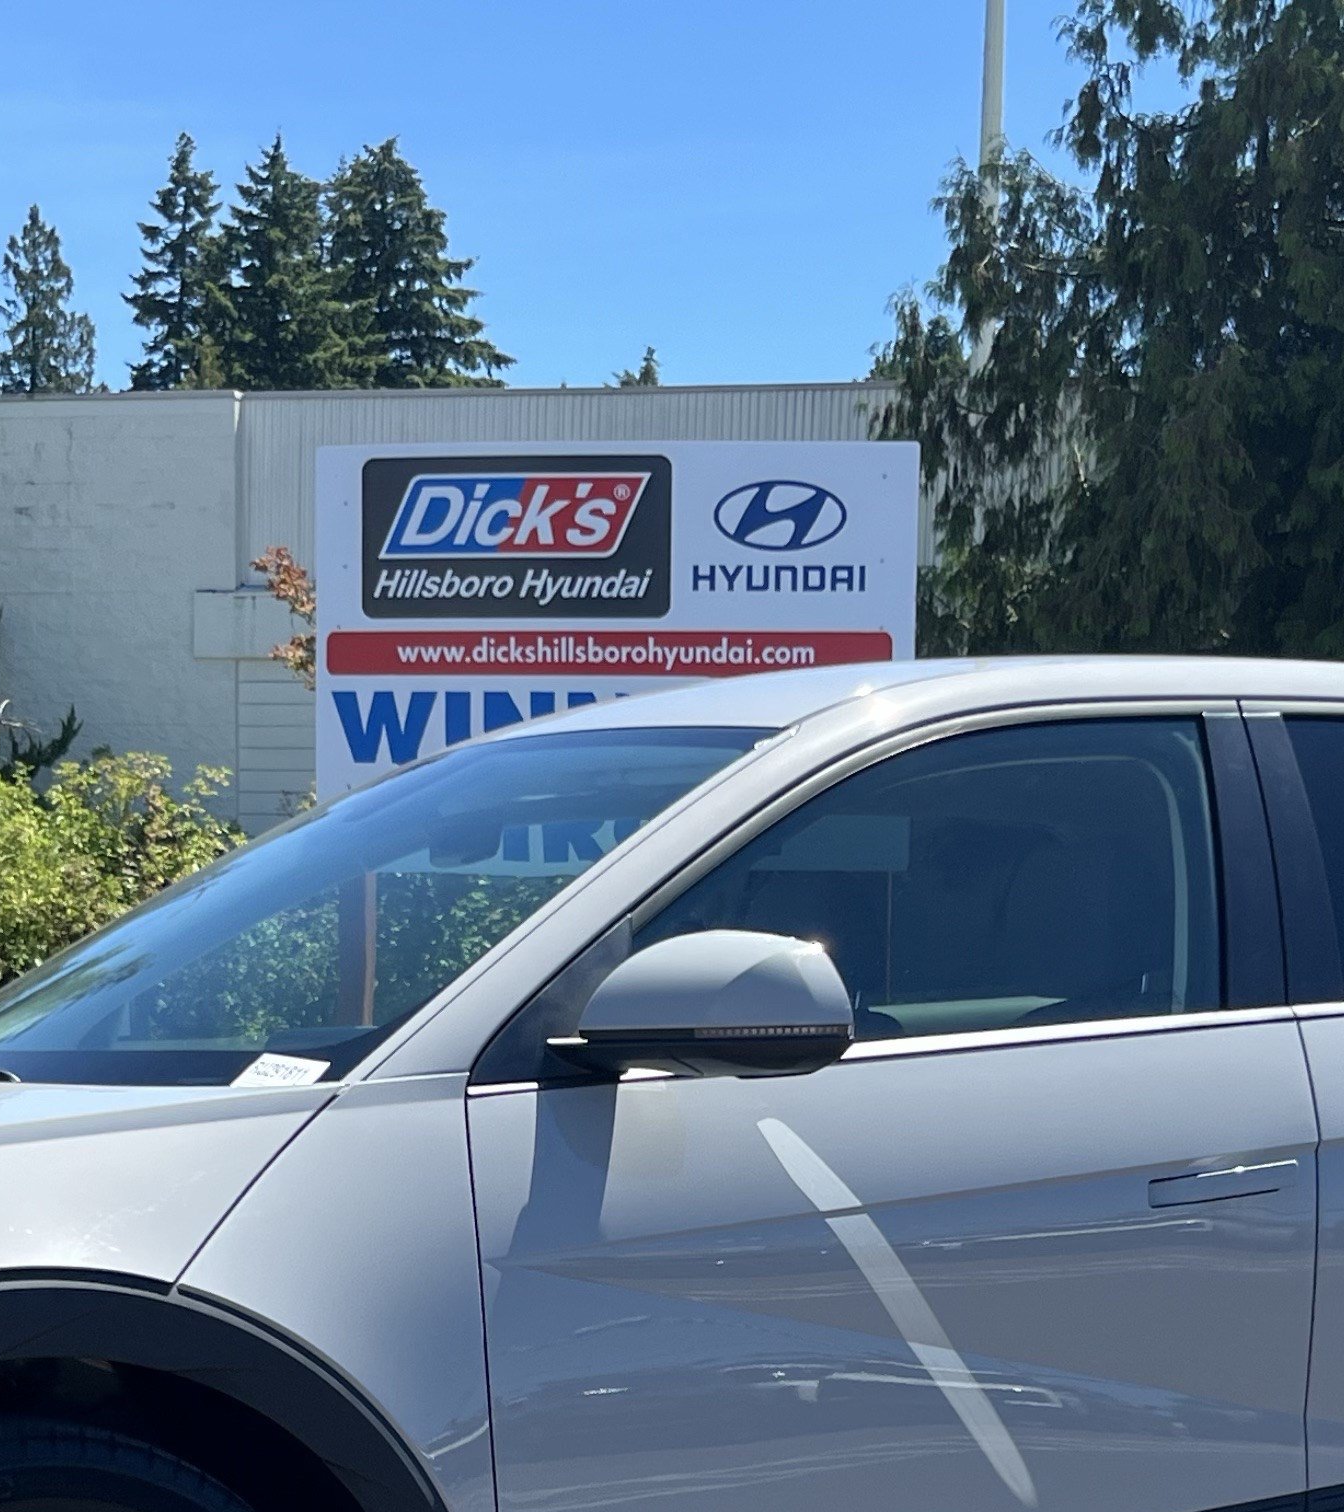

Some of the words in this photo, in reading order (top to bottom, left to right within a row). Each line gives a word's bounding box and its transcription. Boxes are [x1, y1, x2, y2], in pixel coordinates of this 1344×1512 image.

[399, 483, 617, 546] Dick's
[373, 568, 515, 599] Hillsboro
[519, 568, 653, 606] Hyundai
[692, 565, 866, 593] HYUNDAI
[396, 637, 815, 670] www.dickshillsborohyundai.com
